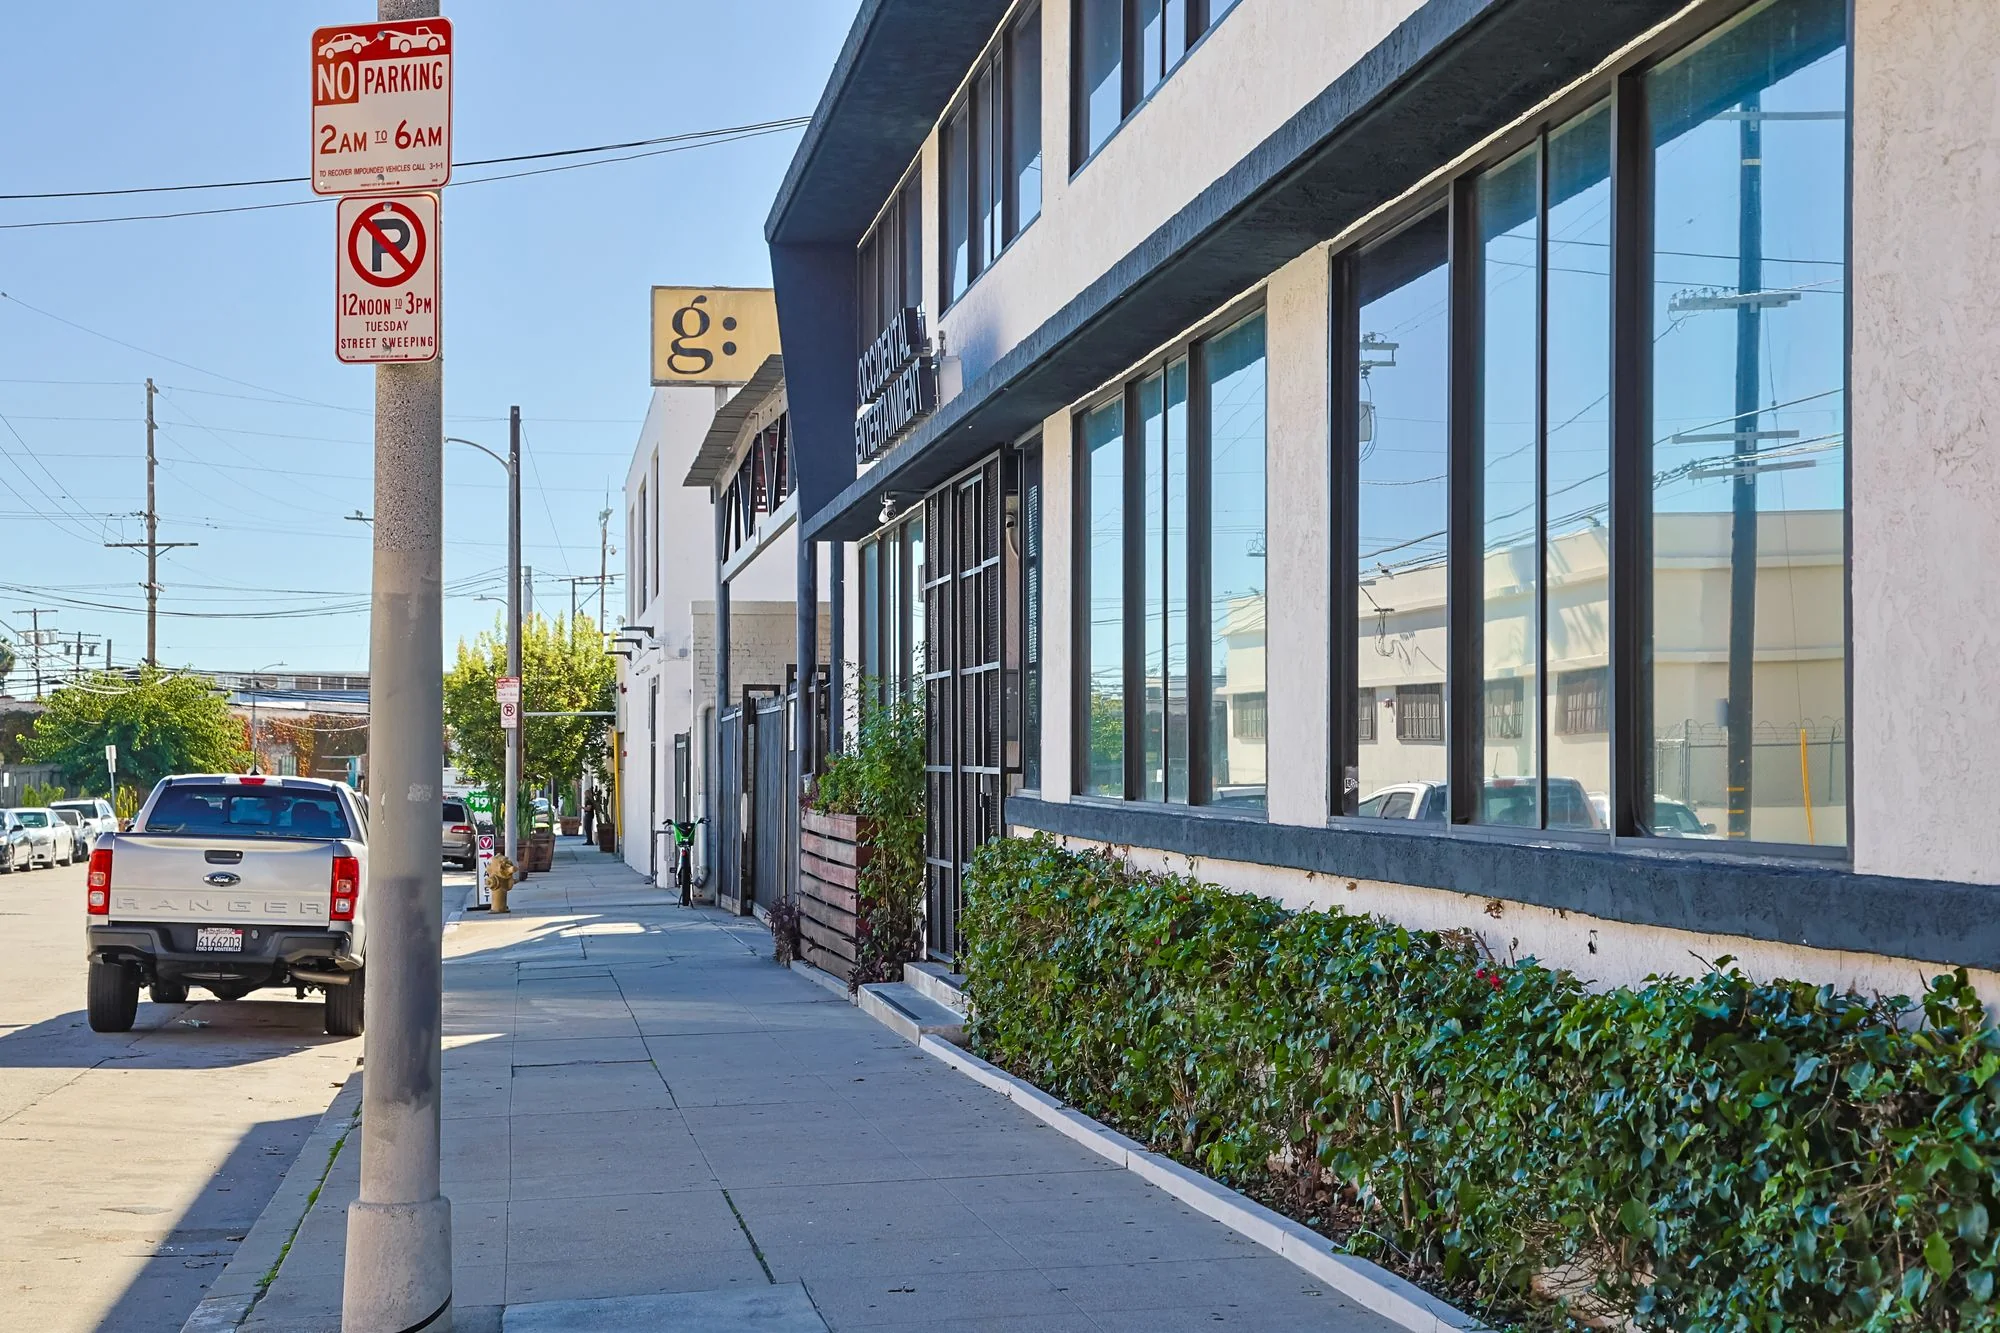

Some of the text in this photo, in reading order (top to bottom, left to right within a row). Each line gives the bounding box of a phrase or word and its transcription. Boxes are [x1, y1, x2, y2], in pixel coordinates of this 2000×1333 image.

[318, 61, 443, 101] NO PARKING
[320, 119, 442, 154] 2AM TO 6AM
[319, 170, 326, 178] TO
[327, 168, 352, 177] RECOVER
[353, 166, 384, 175] IMPOUNDED
[386, 164, 411, 173] VEHICLES
[412, 163, 426, 172] CALL
[342, 293, 391, 316] 12NOON
[405, 291, 432, 315] 3PM
[365, 320, 408, 332] TUESDAY
[340, 336, 433, 349] STREET SWEEPING
[858, 307, 911, 403] OCCIDENTAL
[854, 356, 923, 464] ENTERTAINMENT
[116, 897, 323, 914] RANGER
[198, 936, 241, 948] 61662D3
